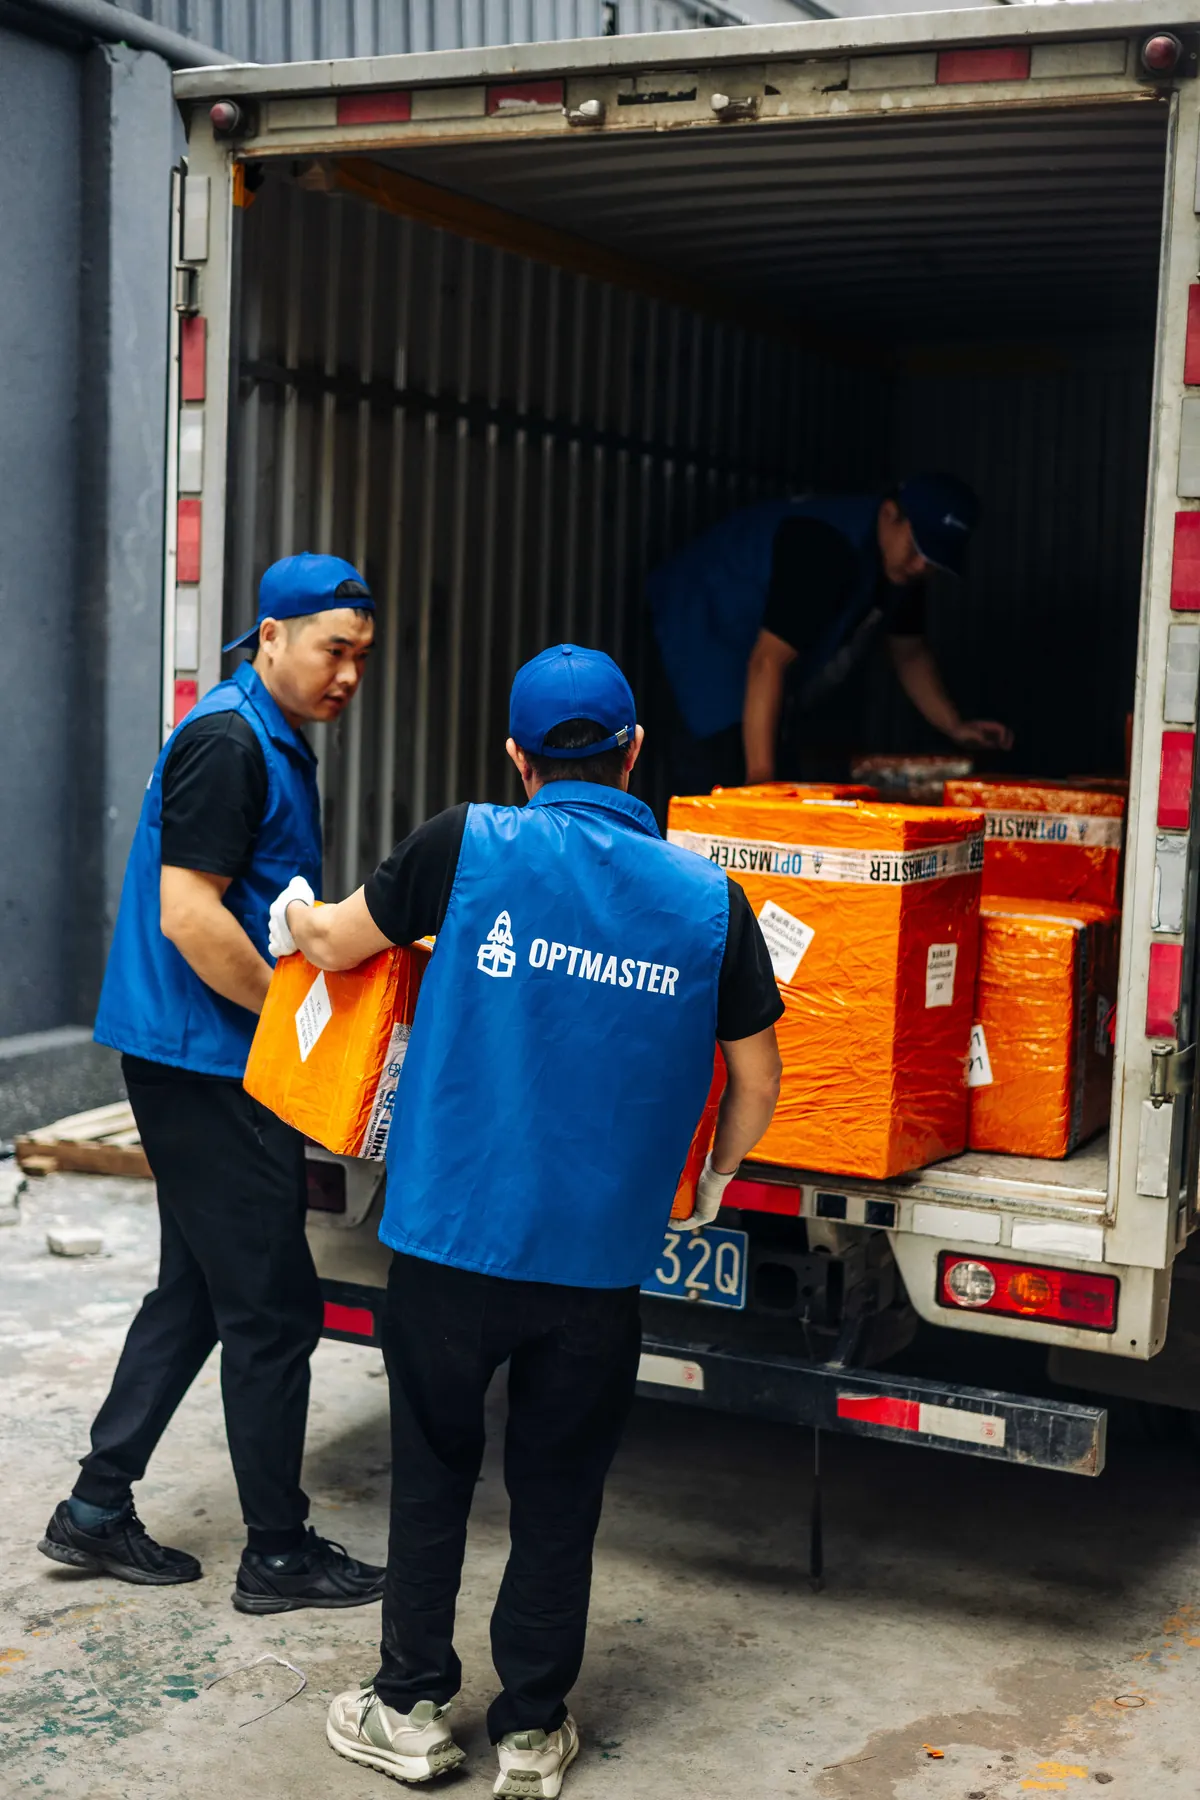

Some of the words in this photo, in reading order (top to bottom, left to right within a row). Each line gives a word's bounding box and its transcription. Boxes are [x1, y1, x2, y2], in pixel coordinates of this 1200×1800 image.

[987, 817, 1067, 841] OPTMASTE
[709, 845, 802, 875] OPTMASTER
[869, 854, 937, 882] OPTMASTER
[528, 937, 680, 996] OPTMASTER
[655, 1232, 740, 1296] 32Q
